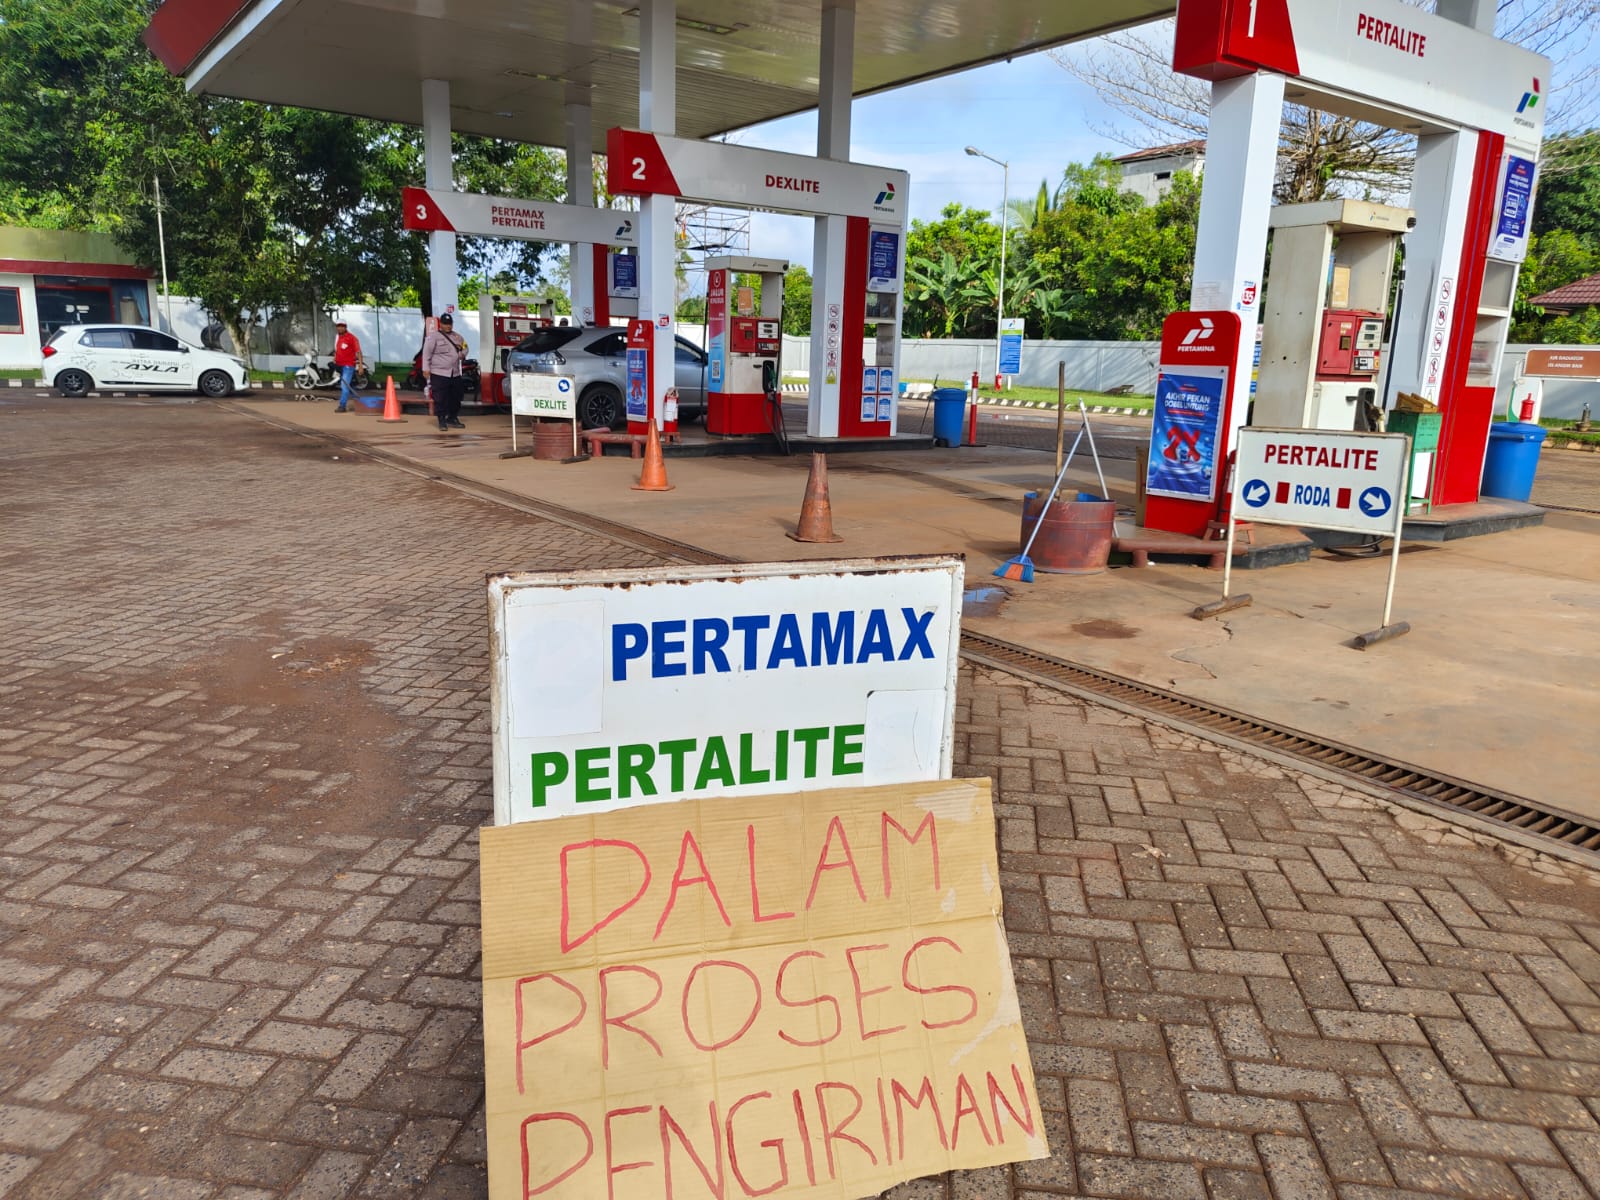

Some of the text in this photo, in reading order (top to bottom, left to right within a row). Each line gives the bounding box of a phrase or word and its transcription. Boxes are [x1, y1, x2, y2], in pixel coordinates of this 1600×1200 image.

[1357, 14, 1426, 57] PERTALITE
[631, 157, 647, 181] 2
[765, 174, 820, 194] DEXLITE
[415, 204, 428, 220] 3
[491, 205, 545, 220] PERTAMAX
[491, 216, 546, 230] PERTALITE
[1177, 345, 1216, 353] PERTAMINA
[125, 363, 178, 373] AYLA
[533, 399, 567, 410] DEXLITE
[1186, 394, 1211, 404] PEKAN
[1264, 443, 1379, 471] PERTALITE
[1294, 484, 1330, 507] RODA
[612, 607, 935, 682] PERTAMAX
[531, 724, 865, 808] PERTALITE
[559, 810, 941, 954] DALAM
[515, 937, 978, 1095] PROSES
[520, 1064, 1037, 1200] PENGIRIMAN
